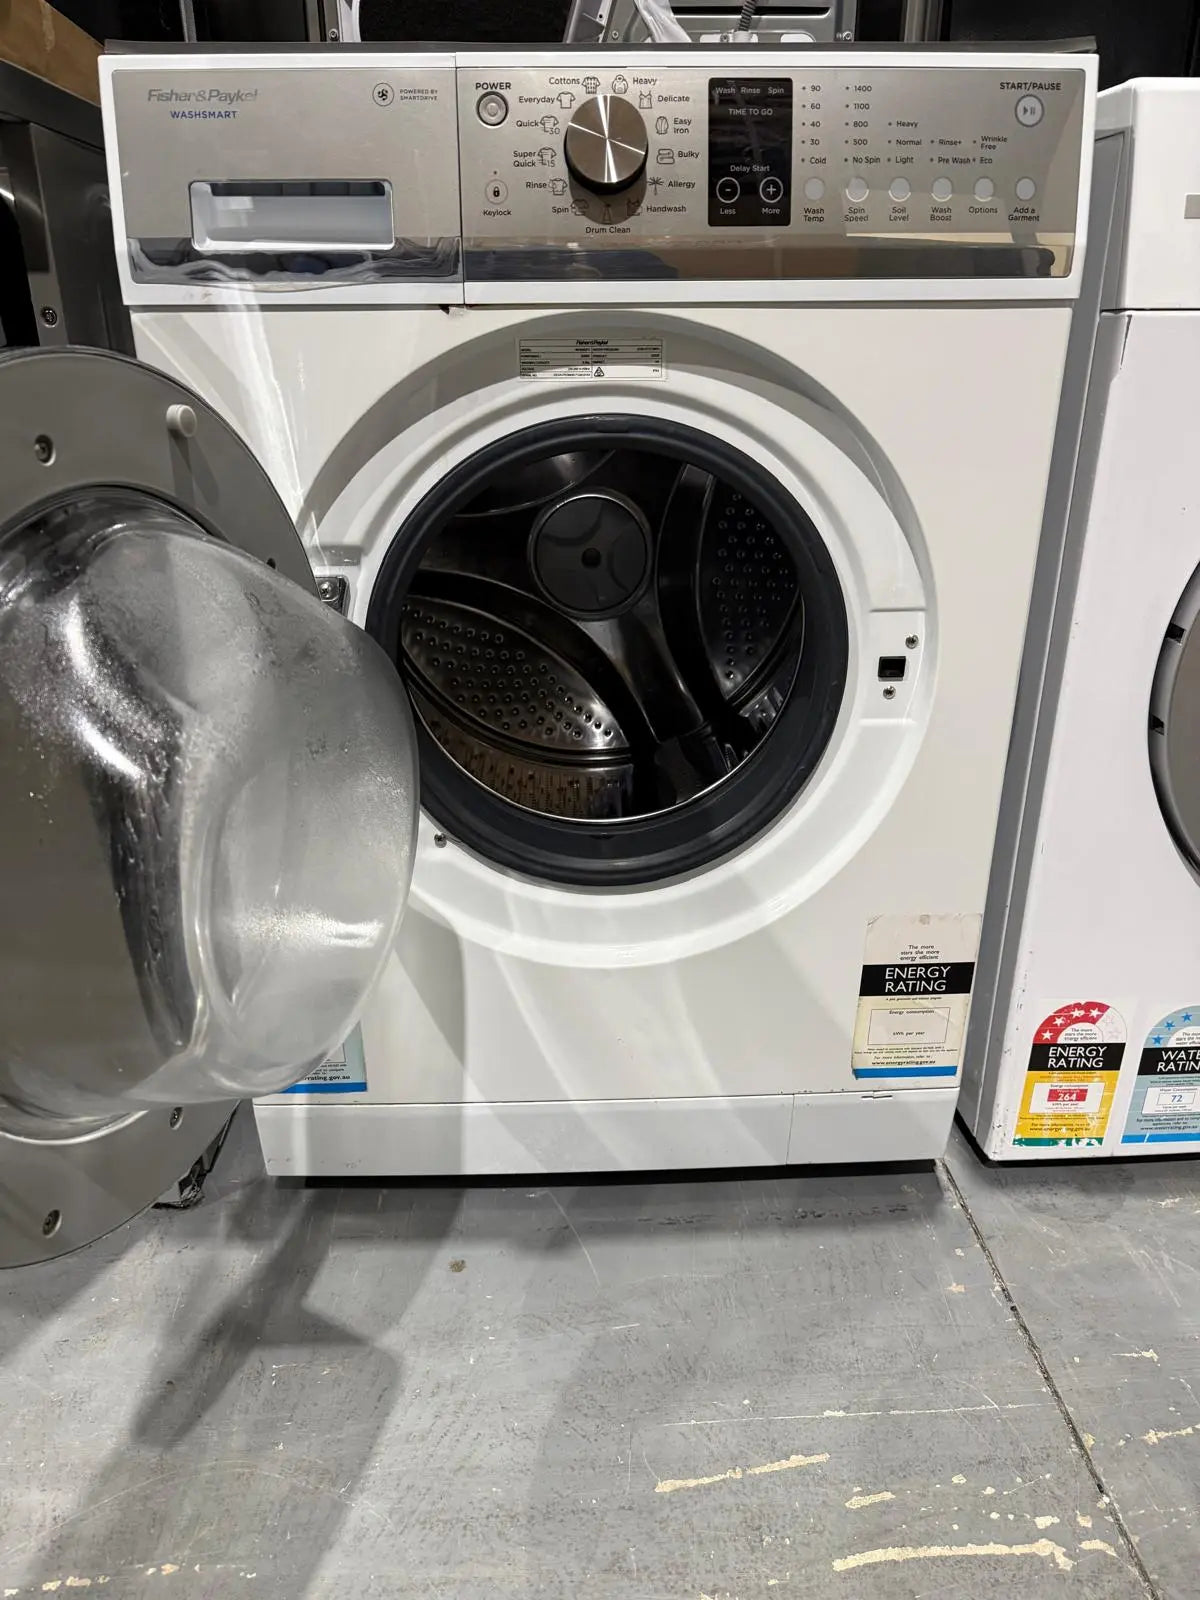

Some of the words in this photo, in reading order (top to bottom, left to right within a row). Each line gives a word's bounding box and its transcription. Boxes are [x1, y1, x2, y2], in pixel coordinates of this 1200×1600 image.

[549, 77, 580, 85] Cottons
[633, 77, 657, 85] Heavy
[475, 82, 511, 90] POWER
[999, 82, 1061, 91] START/PAUSE
[715, 86, 736, 95] Wash
[740, 86, 761, 95] Rinse
[768, 87, 785, 96] Spin
[518, 96, 555, 105] Everyday
[170, 110, 237, 119] WASHSMART
[728, 108, 747, 116] TIME
[760, 108, 773, 116] GO
[516, 120, 539, 128] Quick
[674, 118, 692, 126] Easy
[896, 121, 919, 129] Heavy
[678, 151, 699, 159] Bulky
[513, 159, 536, 167] Quick
[864, 156, 881, 165] Spin
[895, 156, 914, 165] Light
[730, 165, 750, 173] Delay
[668, 181, 696, 189] Allergy
[483, 209, 512, 217] Keylock
[552, 206, 569, 214] Spin
[646, 205, 686, 213] Handwash
[720, 207, 736, 215] Less
[762, 207, 781, 215] More
[804, 207, 825, 215] Wash
[848, 207, 866, 215] Spin
[892, 207, 907, 215] Soil
[931, 206, 952, 214] Wash
[968, 206, 998, 215] Options
[1014, 206, 1028, 214] Add
[804, 215, 825, 223] Temp
[844, 214, 869, 222] Speed
[889, 214, 910, 222] Level
[1008, 214, 1040, 222] Garment
[585, 226, 607, 234] Drum
[885, 966, 951, 979] ENERGY
[885, 980, 947, 993] RATING
[1049, 1047, 1107, 1057] ENERGY
[1162, 1050, 1200, 1061] WATE
[1048, 1058, 1104, 1068] RATING
[1157, 1061, 1200, 1072] RATIN
